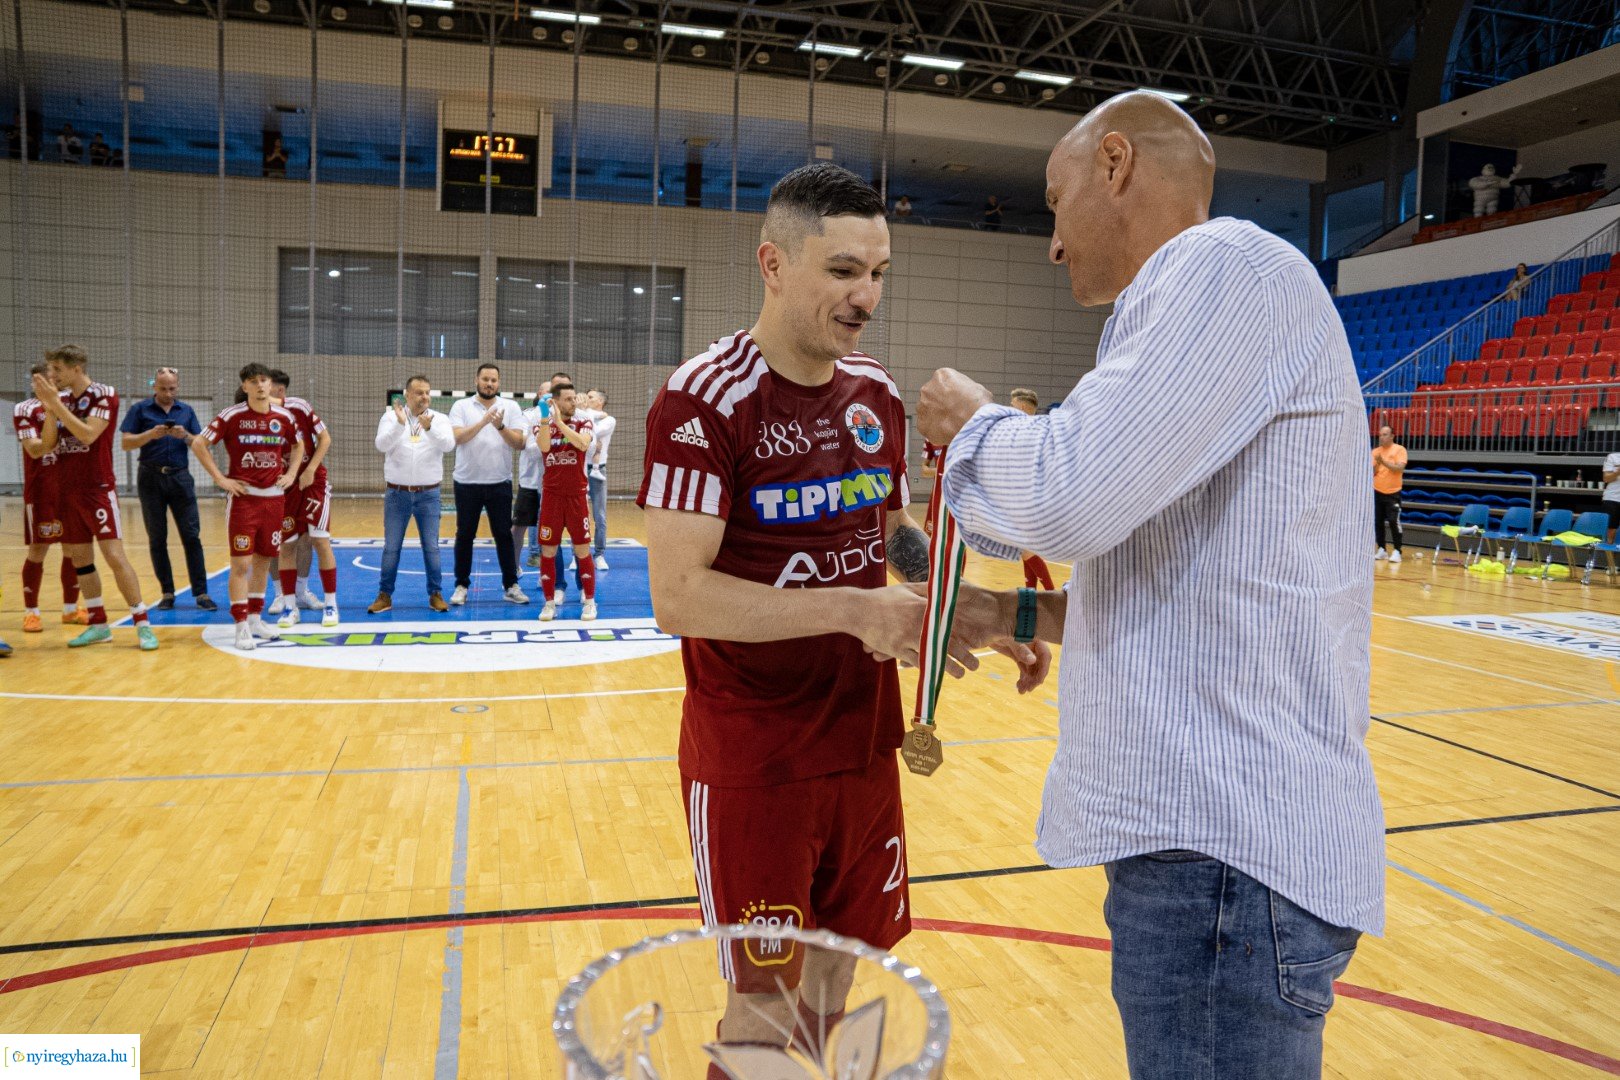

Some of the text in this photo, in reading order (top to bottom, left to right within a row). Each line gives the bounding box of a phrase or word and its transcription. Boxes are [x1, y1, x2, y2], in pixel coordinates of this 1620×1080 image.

[816, 417, 831, 427] the
[670, 431, 709, 449] adidas
[755, 420, 812, 459] 383
[820, 441, 840, 451] water
[305, 497, 321, 514] 77
[95, 507, 109, 525] 9
[883, 831, 905, 893] 2
[760, 935, 782, 955] FM
